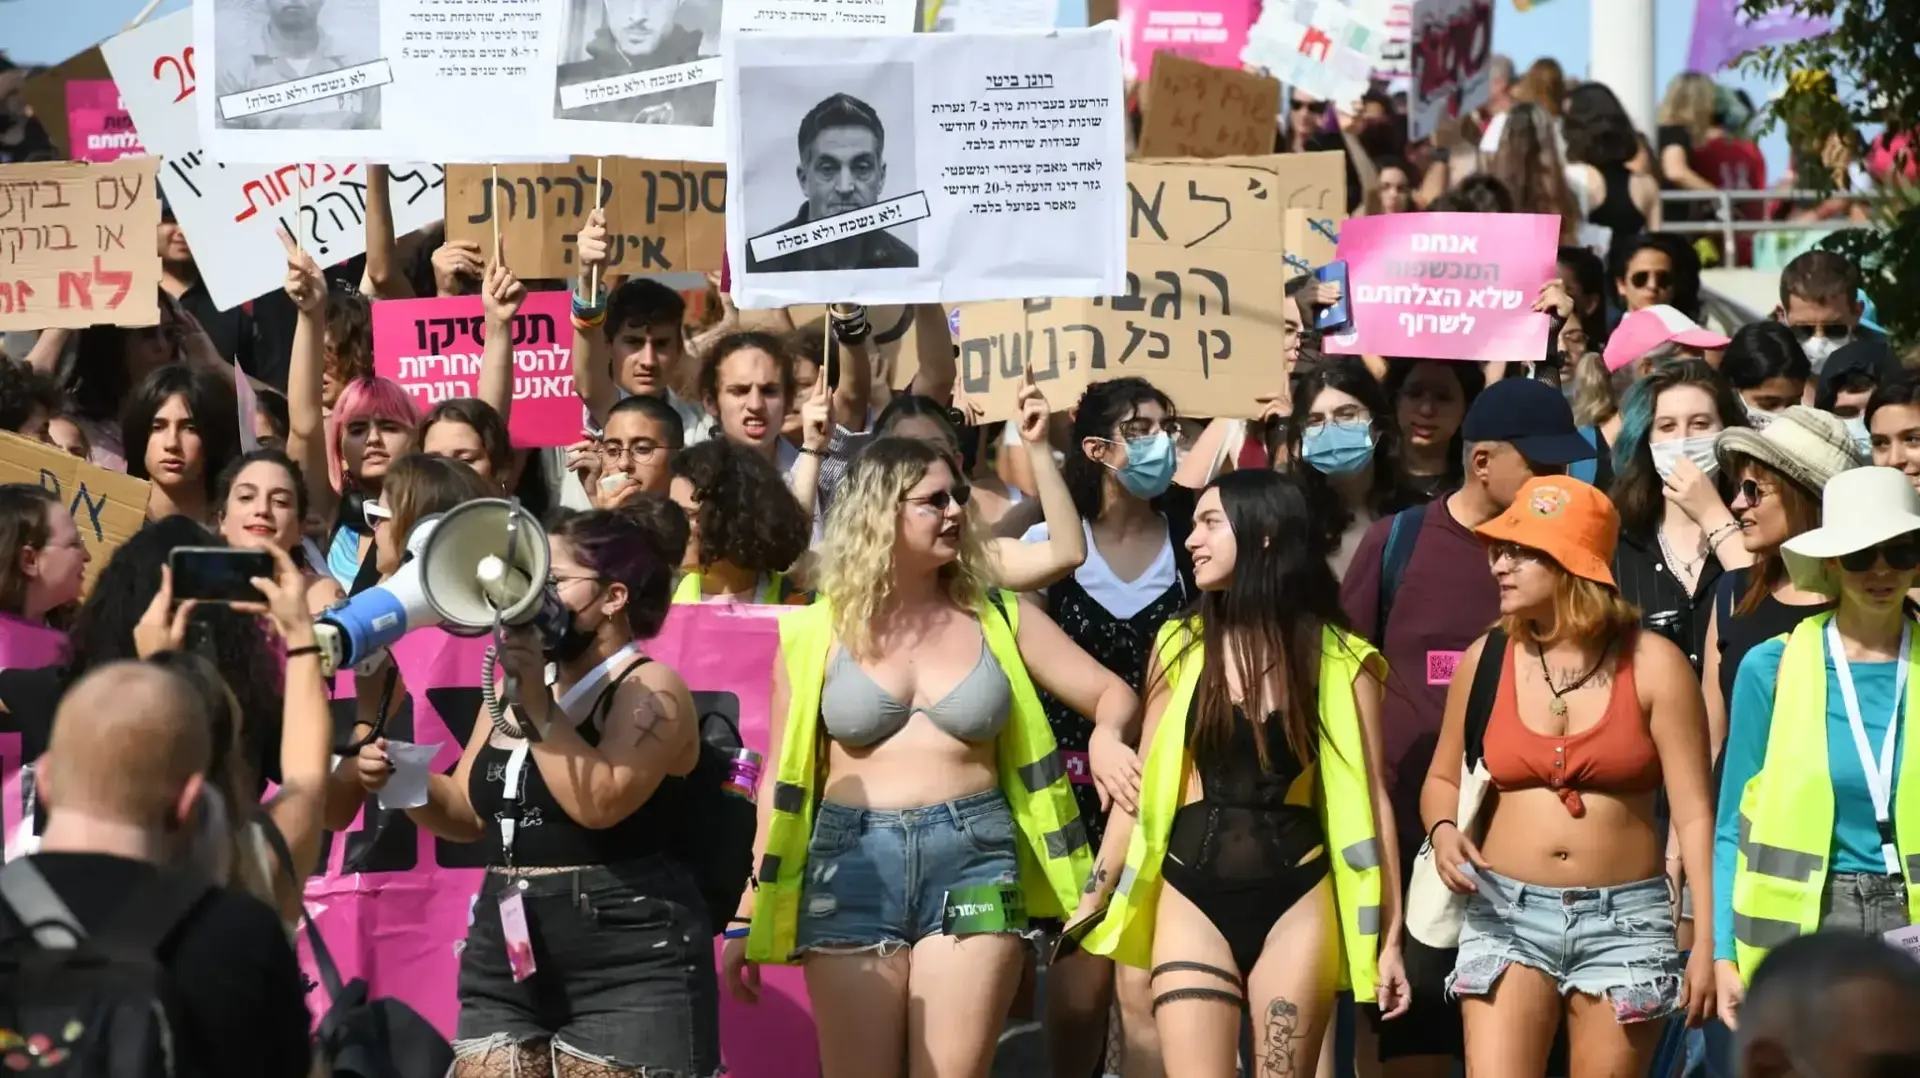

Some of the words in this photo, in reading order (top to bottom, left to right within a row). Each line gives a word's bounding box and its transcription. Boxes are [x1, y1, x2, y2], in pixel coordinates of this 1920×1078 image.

[480, 49, 506, 57] שנים
[350, 70, 366, 85] לא
[471, 67, 498, 76] שנים
[687, 66, 703, 80] לא
[650, 72, 683, 87] נשכח
[986, 75, 1019, 87] ביטי
[1025, 74, 1052, 86] רונן
[286, 85, 307, 100] ולא
[312, 79, 346, 95] נשכח
[624, 79, 648, 94] ולא
[932, 104, 965, 113] נערות
[970, 101, 990, 111] ב-7
[994, 102, 1013, 113] מין
[1017, 100, 1065, 110] בעבירות
[1070, 98, 1108, 109] הורשע
[939, 122, 975, 132] חודשי
[980, 120, 987, 130] 9
[992, 118, 1028, 130] תחילה
[1032, 117, 1064, 129] וקיבל
[1068, 118, 1102, 127] שונות
[963, 138, 994, 150] בלבד.
[999, 139, 1035, 149] שירות
[1040, 138, 1080, 147] עבודות
[941, 165, 989, 177] ומשפטי,
[994, 164, 1031, 174] ציבורי
[1036, 163, 1067, 174] מאבק
[1072, 159, 1102, 171] לאחר
[944, 185, 979, 195] חודשי
[985, 181, 1012, 194] ל-20
[1016, 181, 1052, 192] הועלה
[1057, 182, 1078, 191] דינו
[1083, 180, 1101, 189] גזר
[95, 173, 143, 211] עם
[468, 165, 613, 224] להיות
[970, 201, 1002, 213] בלבד.
[1006, 200, 1040, 212] בפועל
[1044, 201, 1076, 210] מאסר
[838, 214, 875, 234] נשכח
[812, 225, 835, 238] ולא
[776, 234, 809, 251] נסלח
[57, 255, 134, 311] לא
[1356, 283, 1462, 307] הצלחתם
[1466, 286, 1523, 310] שלא
[1398, 311, 1476, 338] לשרוף
[1118, 320, 1171, 366] כל
[1197, 328, 1232, 380] כן
